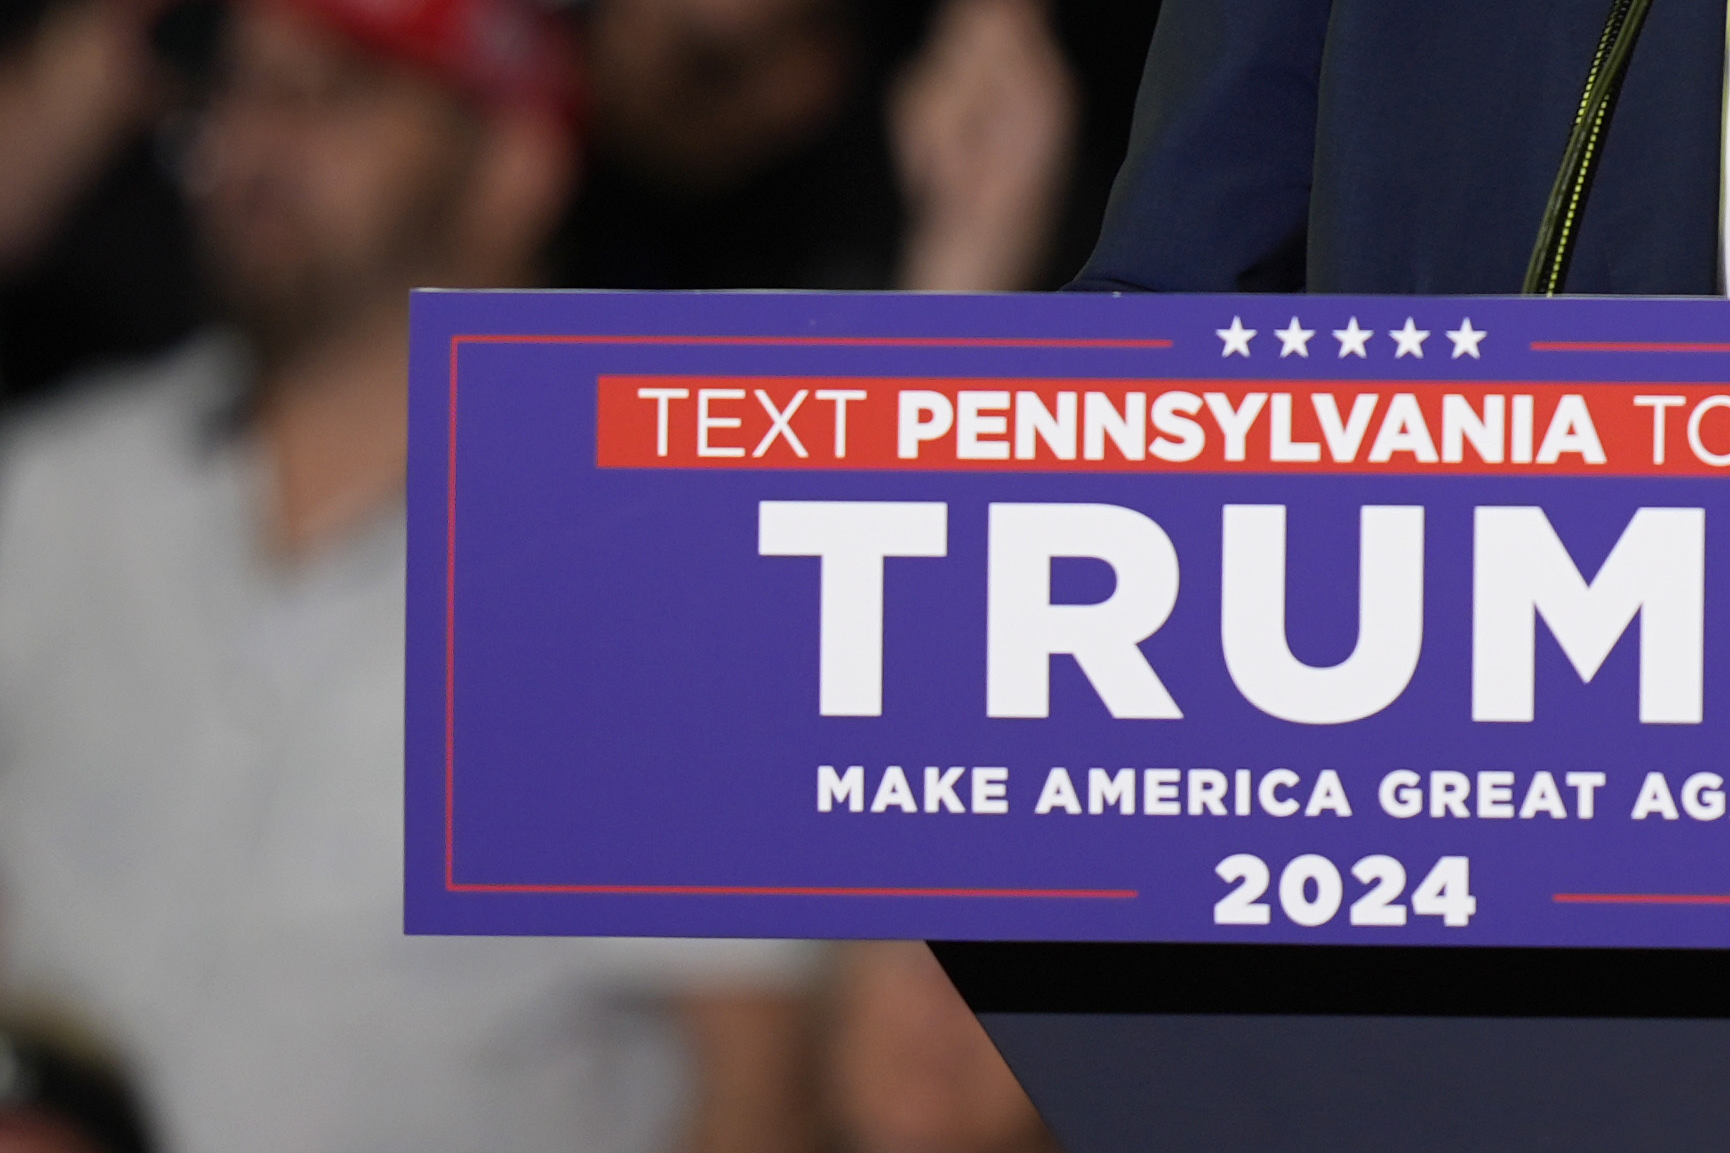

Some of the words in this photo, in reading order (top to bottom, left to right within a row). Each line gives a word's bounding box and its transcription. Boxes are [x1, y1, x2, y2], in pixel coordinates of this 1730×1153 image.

[637, 388, 867, 458] TEXT
[897, 390, 1607, 464] PENNSYLVANIA
[817, 765, 1009, 814] MAKE
[1034, 767, 1352, 817] AMERICA
[1378, 769, 1606, 819] GREAT
[1214, 853, 1476, 927] 2024
